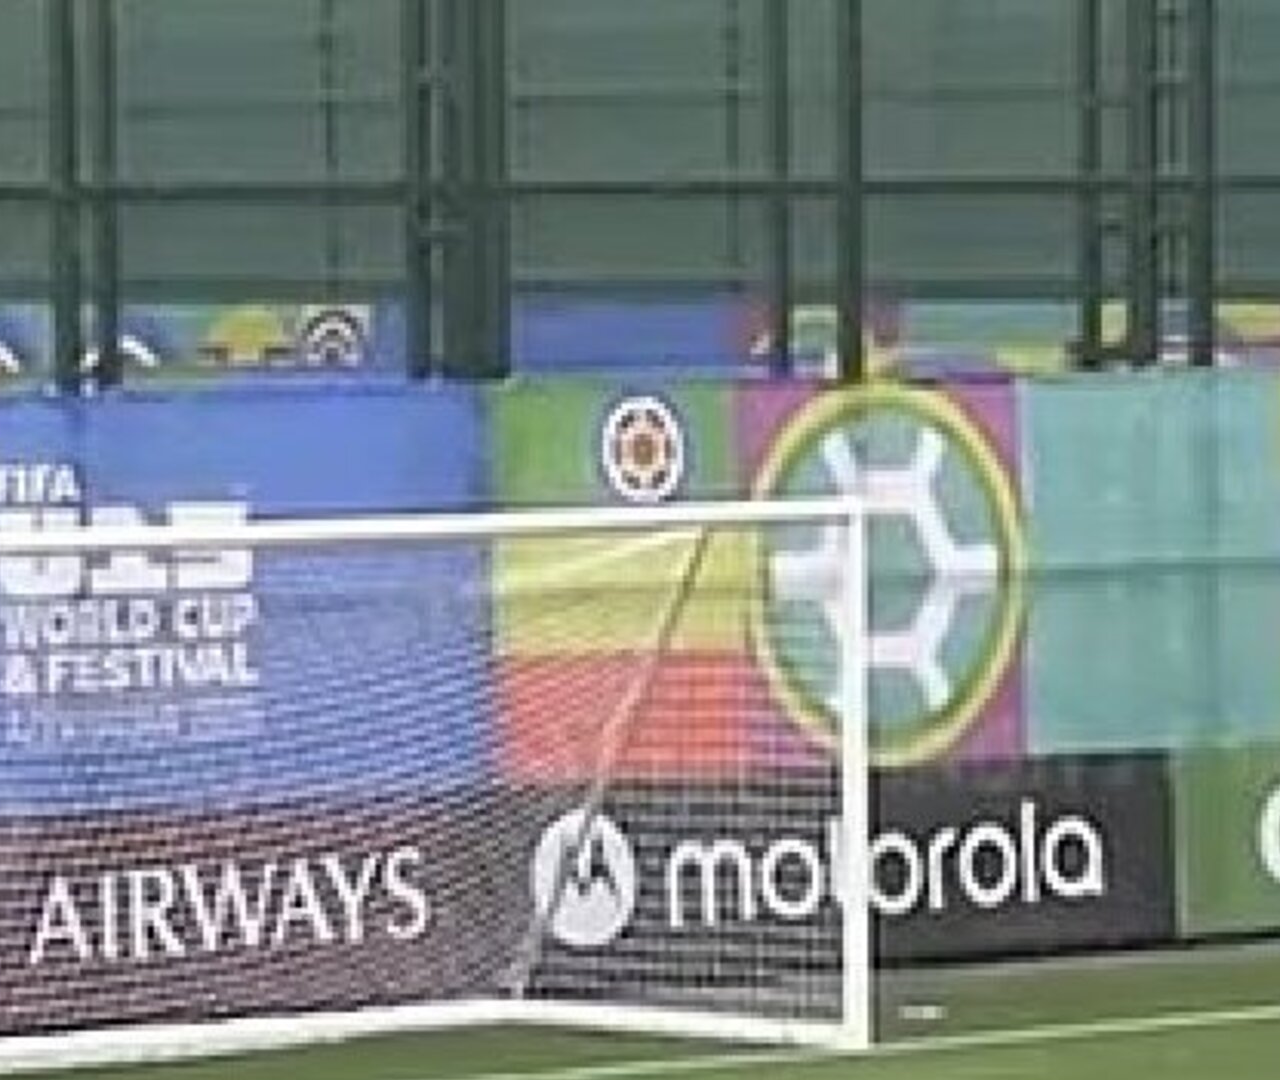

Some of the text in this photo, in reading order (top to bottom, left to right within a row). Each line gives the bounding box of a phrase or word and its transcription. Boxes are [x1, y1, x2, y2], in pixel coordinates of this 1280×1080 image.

[0, 593, 259, 649] WORLD CUP
[0, 642, 259, 694] & FESTIVAL
[29, 847, 429, 966] AIRWAYS
[668, 799, 1105, 927] motorola
